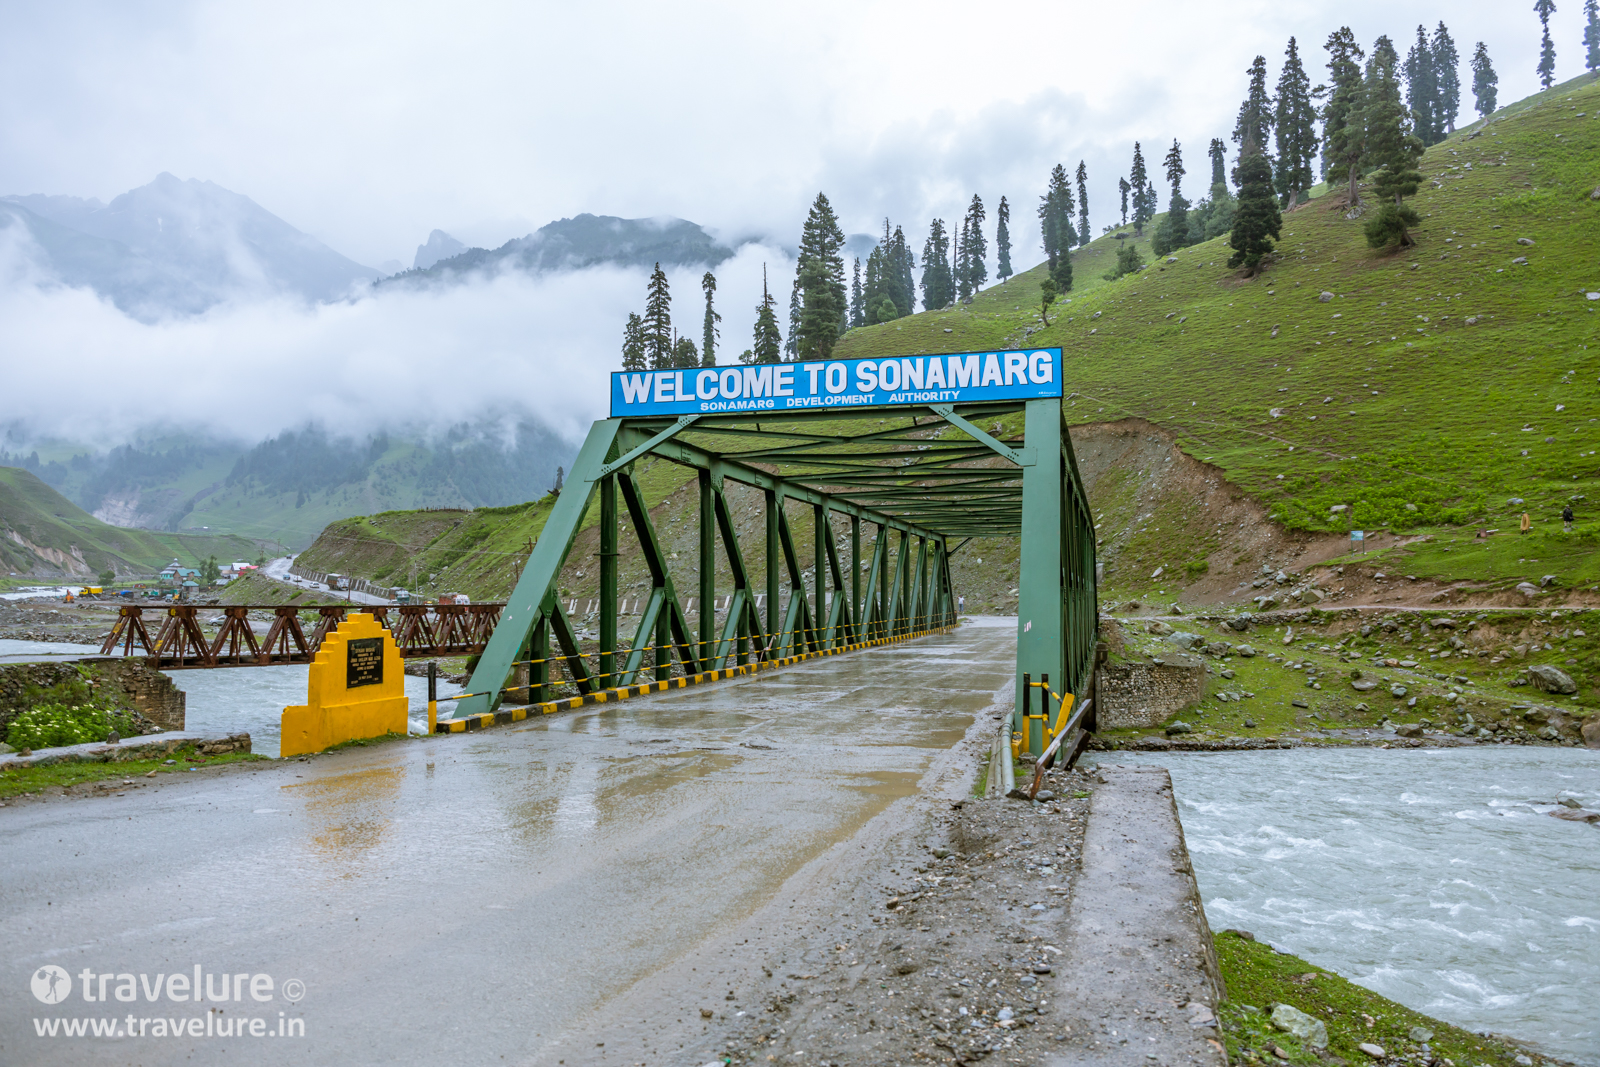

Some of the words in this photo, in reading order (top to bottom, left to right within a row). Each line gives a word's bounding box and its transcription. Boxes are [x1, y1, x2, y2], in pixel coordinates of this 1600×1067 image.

[619, 364, 795, 405] WELCOME
[803, 362, 848, 395] TO
[856, 350, 1054, 393] SONAMARG
[700, 399, 775, 411] SONAMARG
[786, 394, 875, 407] DEVELOPMENT
[888, 390, 961, 403] AUTHORITY
